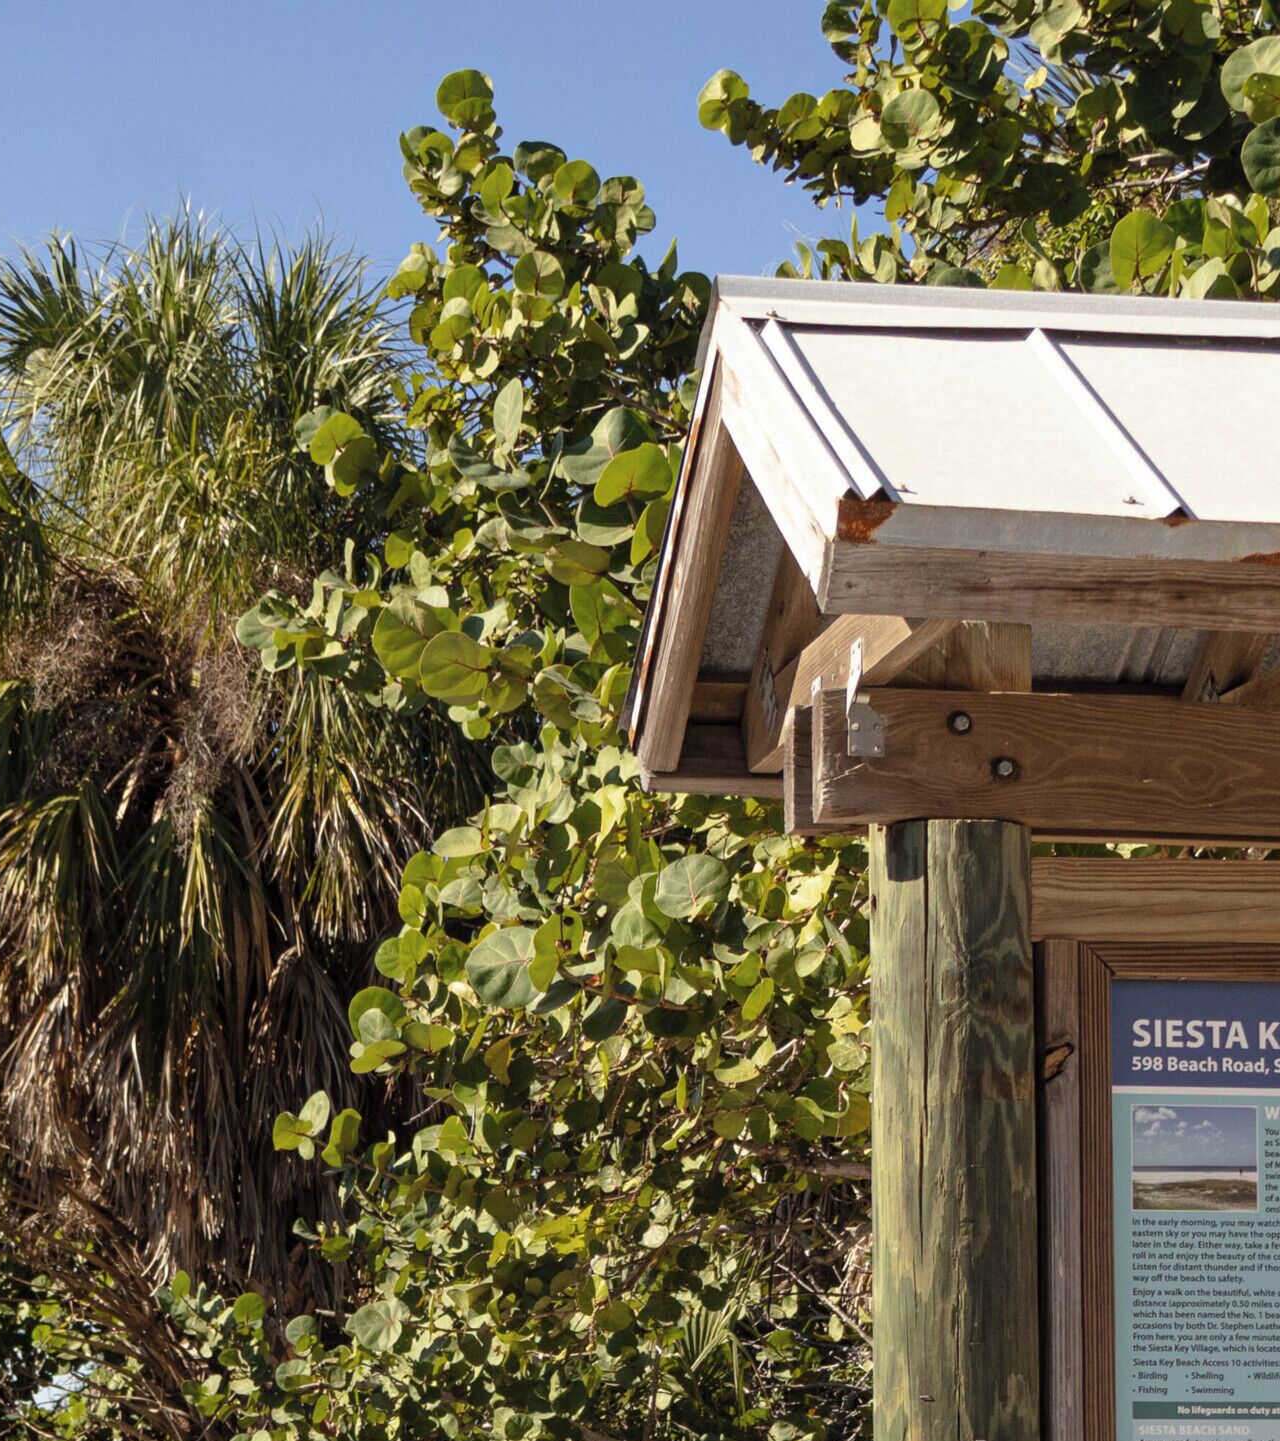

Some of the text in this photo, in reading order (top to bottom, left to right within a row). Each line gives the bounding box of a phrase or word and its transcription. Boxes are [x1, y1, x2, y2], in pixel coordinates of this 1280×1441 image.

[1132, 1019, 1248, 1052] SIESTA
[1132, 1056, 1163, 1072] 598
[1167, 1057, 1217, 1073] Beach
[1222, 1058, 1269, 1076] Road,
[1264, 1128, 1279, 1137] You
[1138, 1372, 1167, 1383] Birding
[1191, 1372, 1224, 1383] Shelling
[1138, 1386, 1167, 1397] Fishing
[1191, 1386, 1234, 1397] Swimming
[1177, 1406, 1190, 1415] No
[1191, 1406, 1235, 1417] lifeguards
[1249, 1406, 1270, 1417] duty
[1271, 1406, 1280, 1415] at
[1139, 1425, 1249, 1436] SIESTA BEACH SAND
